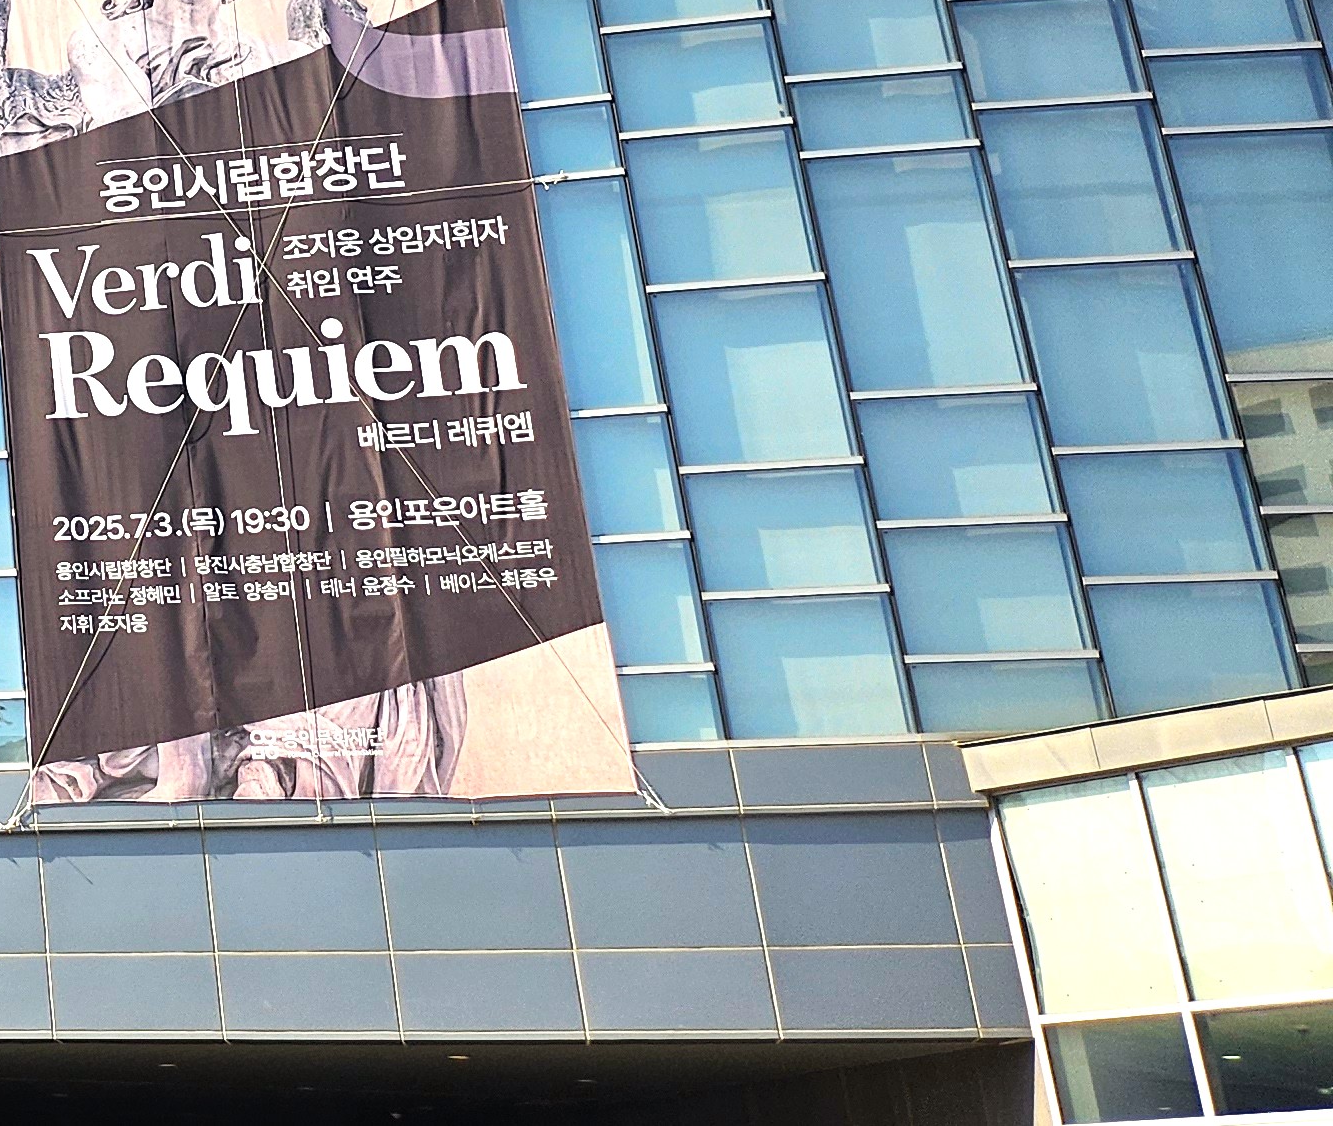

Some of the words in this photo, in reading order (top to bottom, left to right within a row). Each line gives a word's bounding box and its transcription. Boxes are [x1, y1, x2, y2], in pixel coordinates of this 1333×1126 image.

[99, 142, 406, 214] 용인시립합창단
[282, 228, 365, 261] 조지웅
[368, 216, 509, 257] 상임지휘자
[27, 232, 264, 319] Verdi
[287, 270, 340, 299] 취임
[346, 265, 403, 295] 연주
[39, 317, 528, 437] Requiem
[357, 422, 442, 452] 베르디
[447, 411, 535, 448] 레퀴엠
[231, 506, 310, 534] 19:30
[347, 489, 548, 533] 용인포은아트홀
[55, 558, 171, 581] 용인시립합창단
[194, 551, 331, 575] 당진시충남합창단
[356, 539, 553, 569] 용인필하모닉오케스트라
[58, 588, 125, 607] 소프라노
[130, 585, 181, 604] 정혜민
[203, 582, 239, 601] 알토
[244, 578, 294, 601] 양송미
[321, 578, 356, 598] 테너
[362, 576, 415, 595] 윤정수
[440, 572, 496, 594] 베이스
[501, 568, 558, 589] 최종우
[60, 615, 93, 634] 지휘
[98, 614, 148, 633] 조지웅
